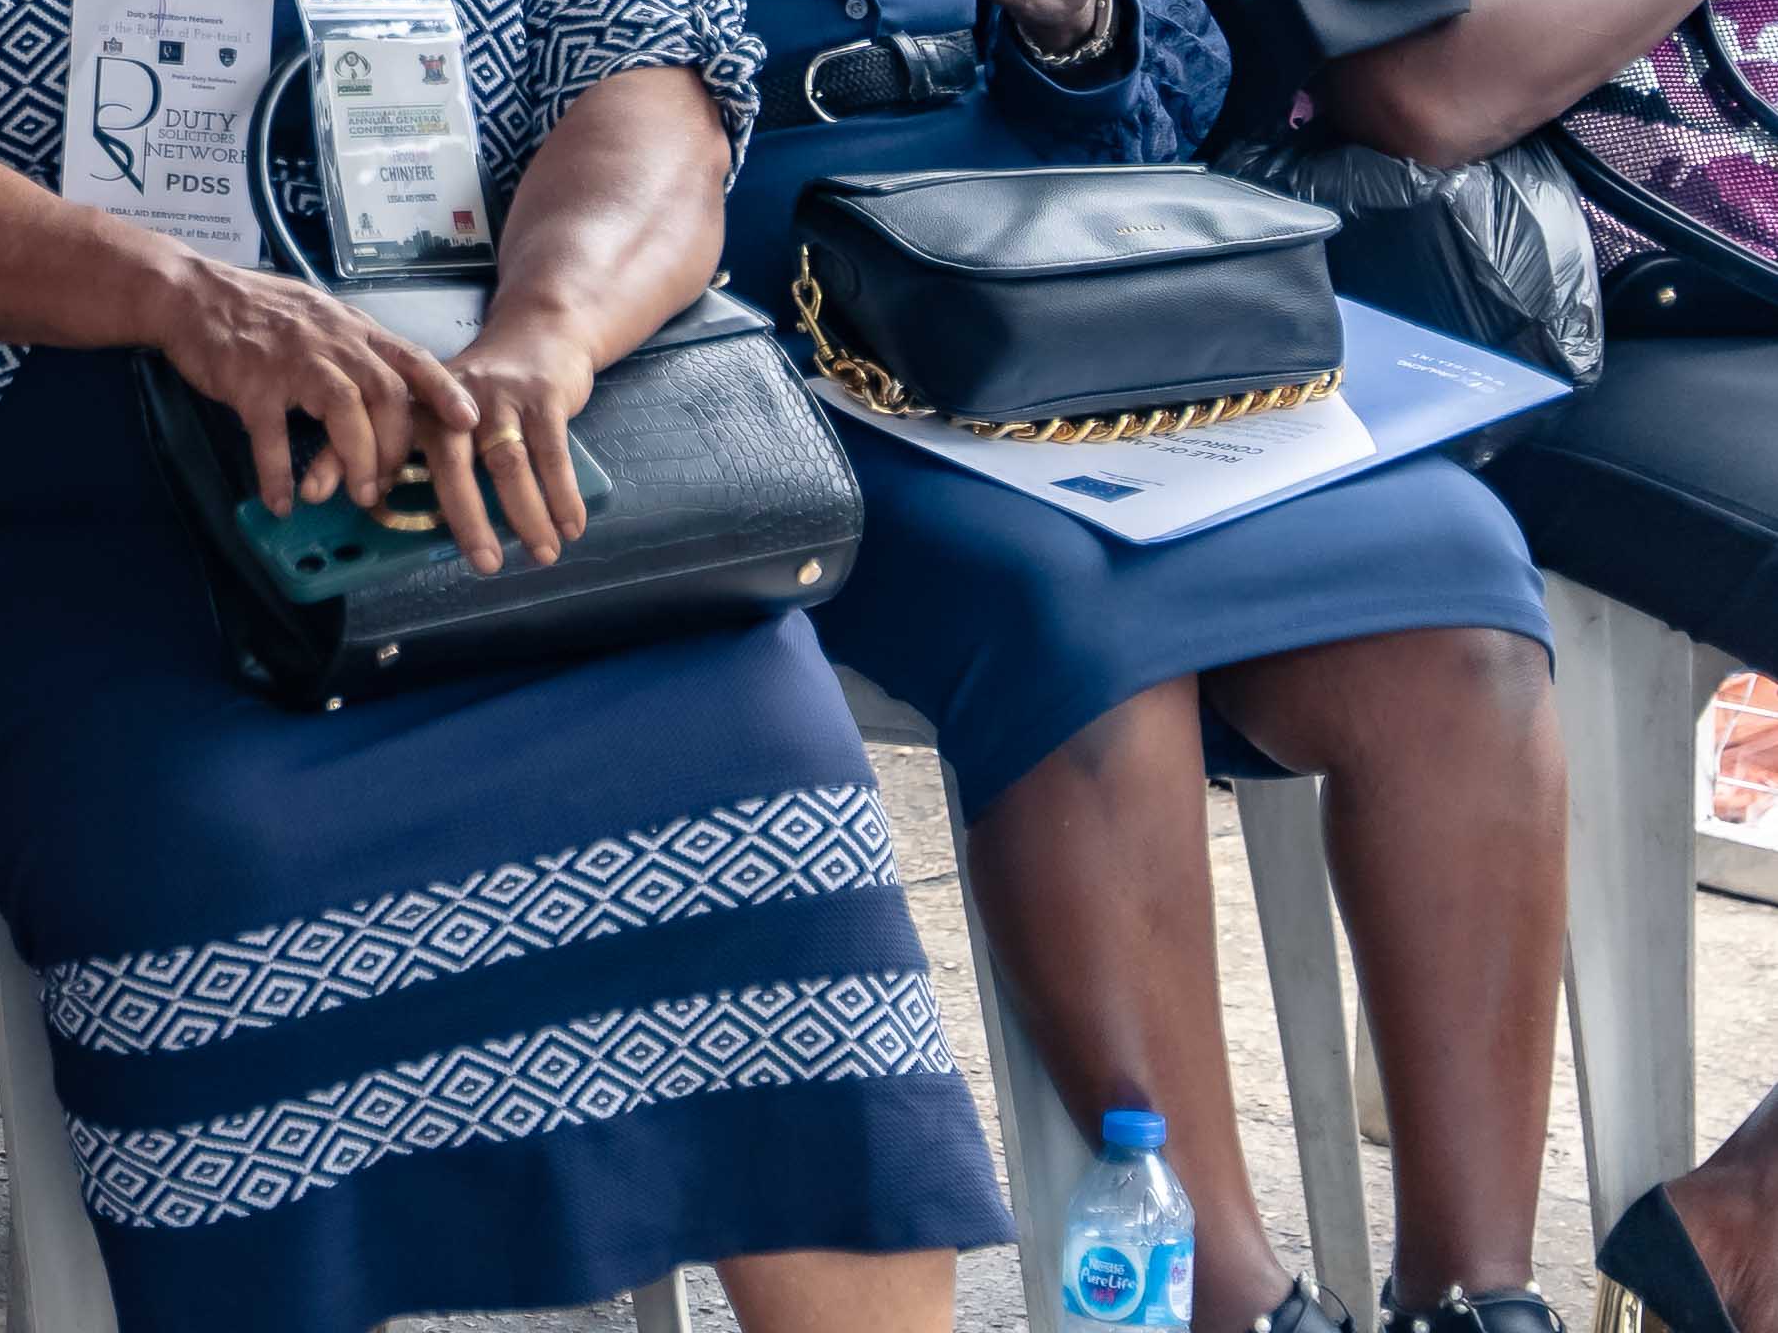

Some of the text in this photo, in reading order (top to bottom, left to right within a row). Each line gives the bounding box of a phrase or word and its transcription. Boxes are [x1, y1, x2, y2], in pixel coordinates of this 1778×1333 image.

[188, 15, 224, 25] Network
[165, 108, 238, 133] DUTY
[348, 115, 441, 125] ANNUAL GENERAL
[157, 128, 236, 145] SOLICITORS
[349, 125, 417, 134] CONFERENCE
[379, 165, 435, 182] CHINYERE
[165, 172, 232, 196] PDSS
[133, 209, 149, 218] AID
[151, 211, 187, 221] SERVICE
[188, 213, 232, 224] PROVIDER
[1158, 445, 1192, 455] OF
[1190, 448, 1243, 464] RULE
